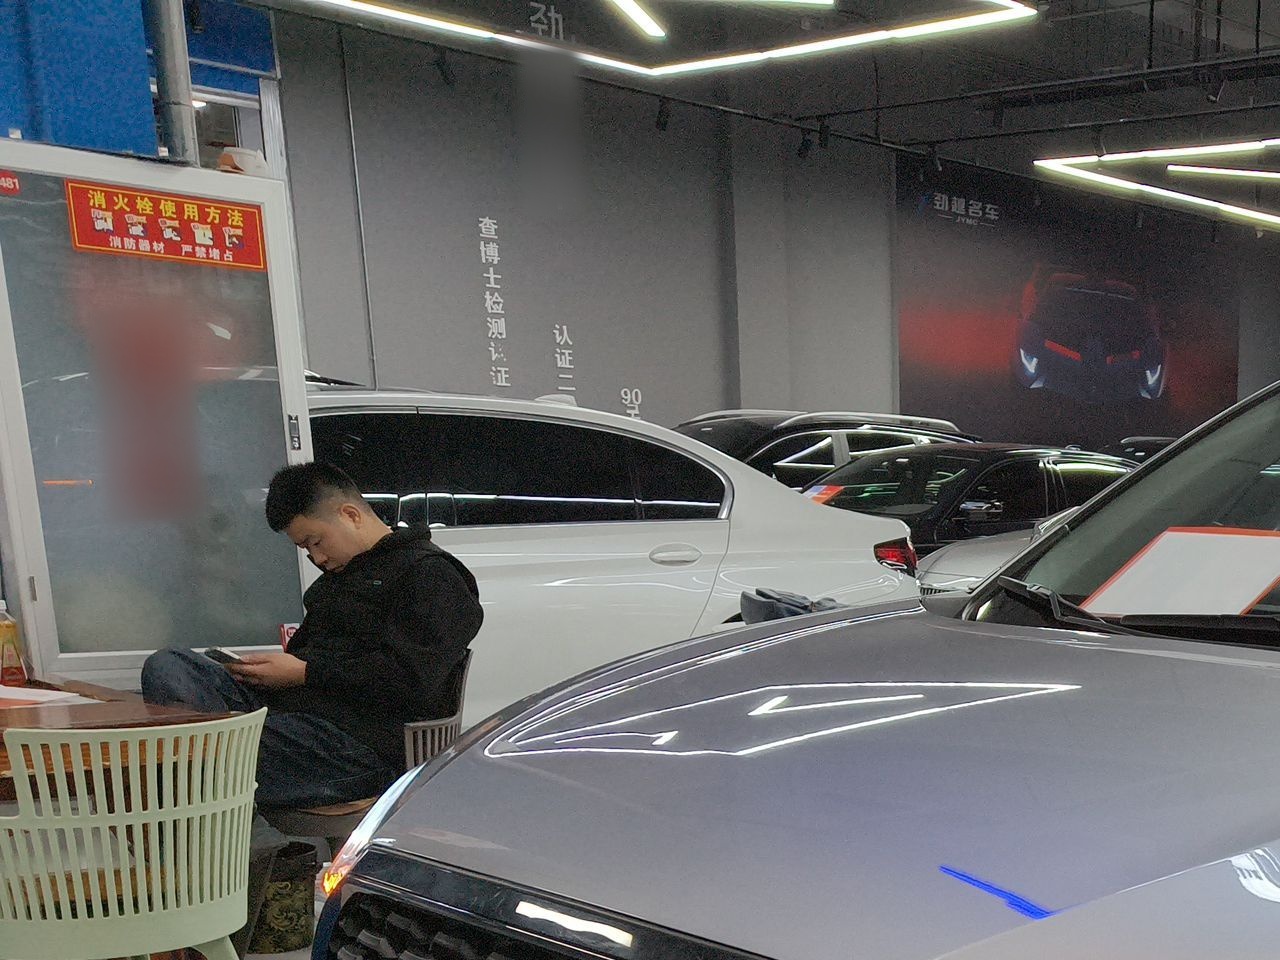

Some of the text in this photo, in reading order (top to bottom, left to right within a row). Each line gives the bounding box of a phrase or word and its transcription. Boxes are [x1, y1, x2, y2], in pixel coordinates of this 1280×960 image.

[87, 189, 244, 228] 消火栓使用方法
[109, 235, 165, 254] 消防器材
[553, 323, 576, 391] 认证二
